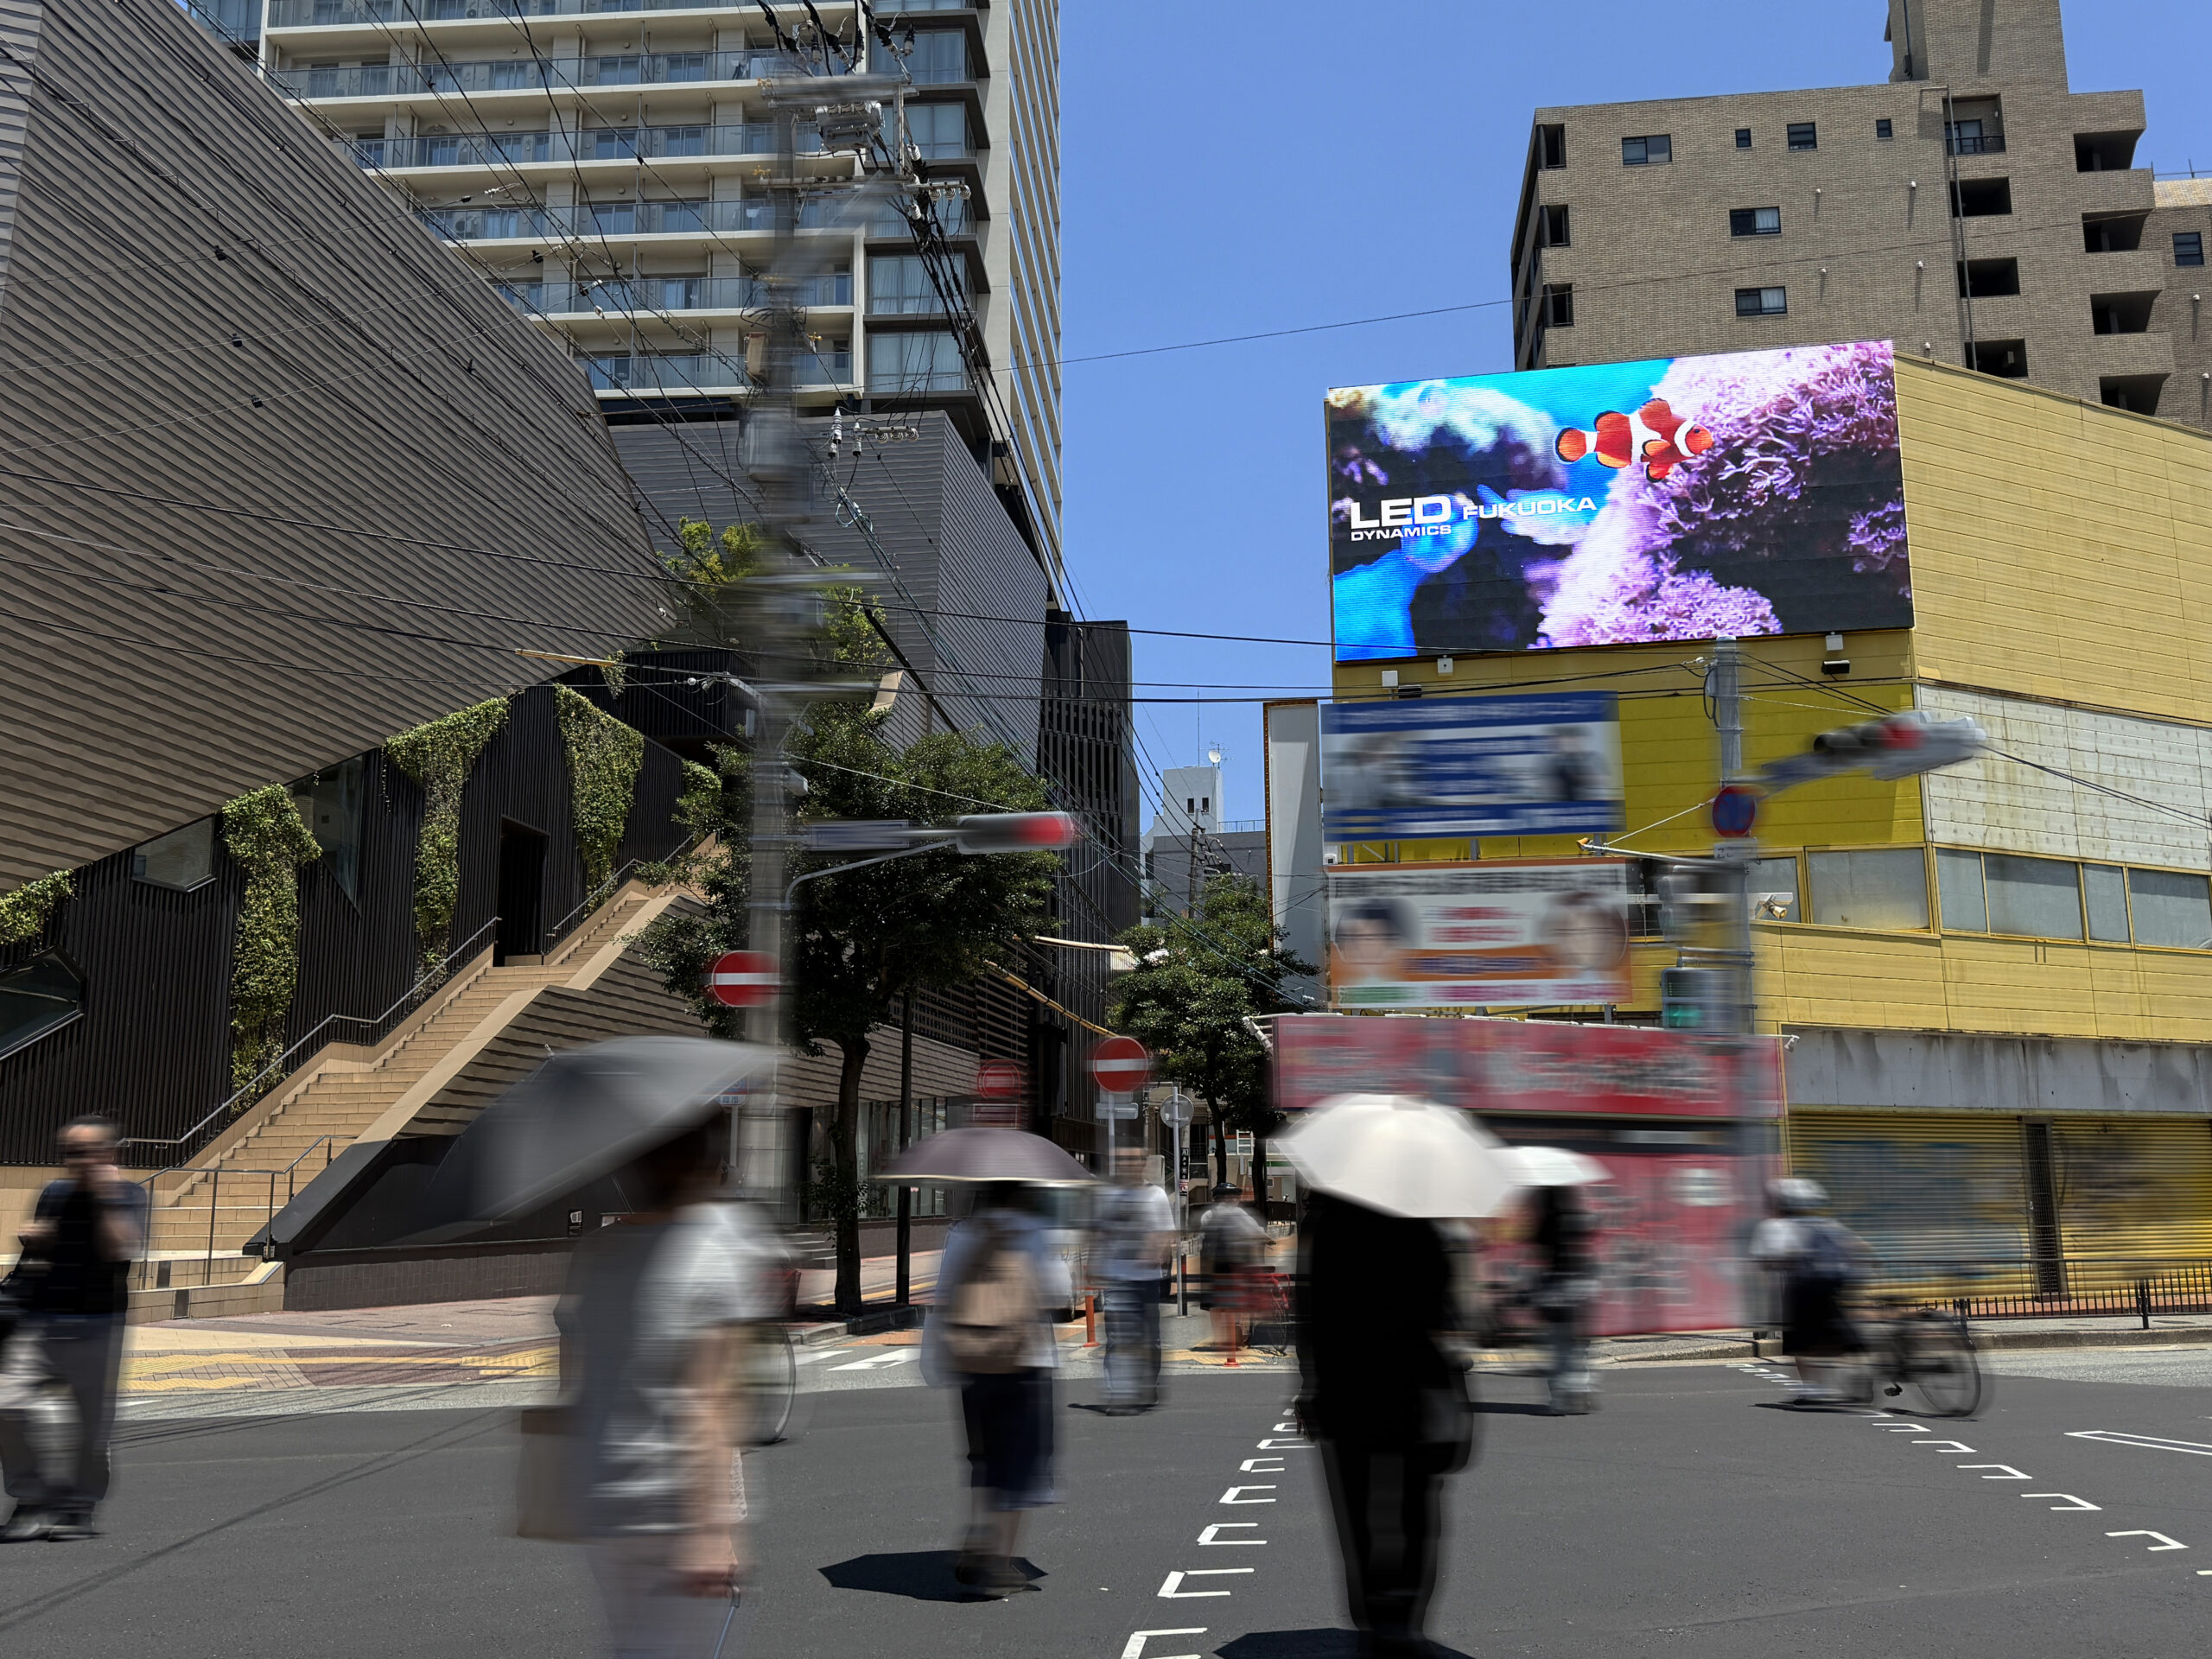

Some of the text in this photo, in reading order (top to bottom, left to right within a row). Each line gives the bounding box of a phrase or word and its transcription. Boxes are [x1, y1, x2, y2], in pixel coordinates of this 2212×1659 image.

[1351, 494, 1598, 529] LED FUKUOKA
[1351, 524, 1452, 542] DYNAMICS
